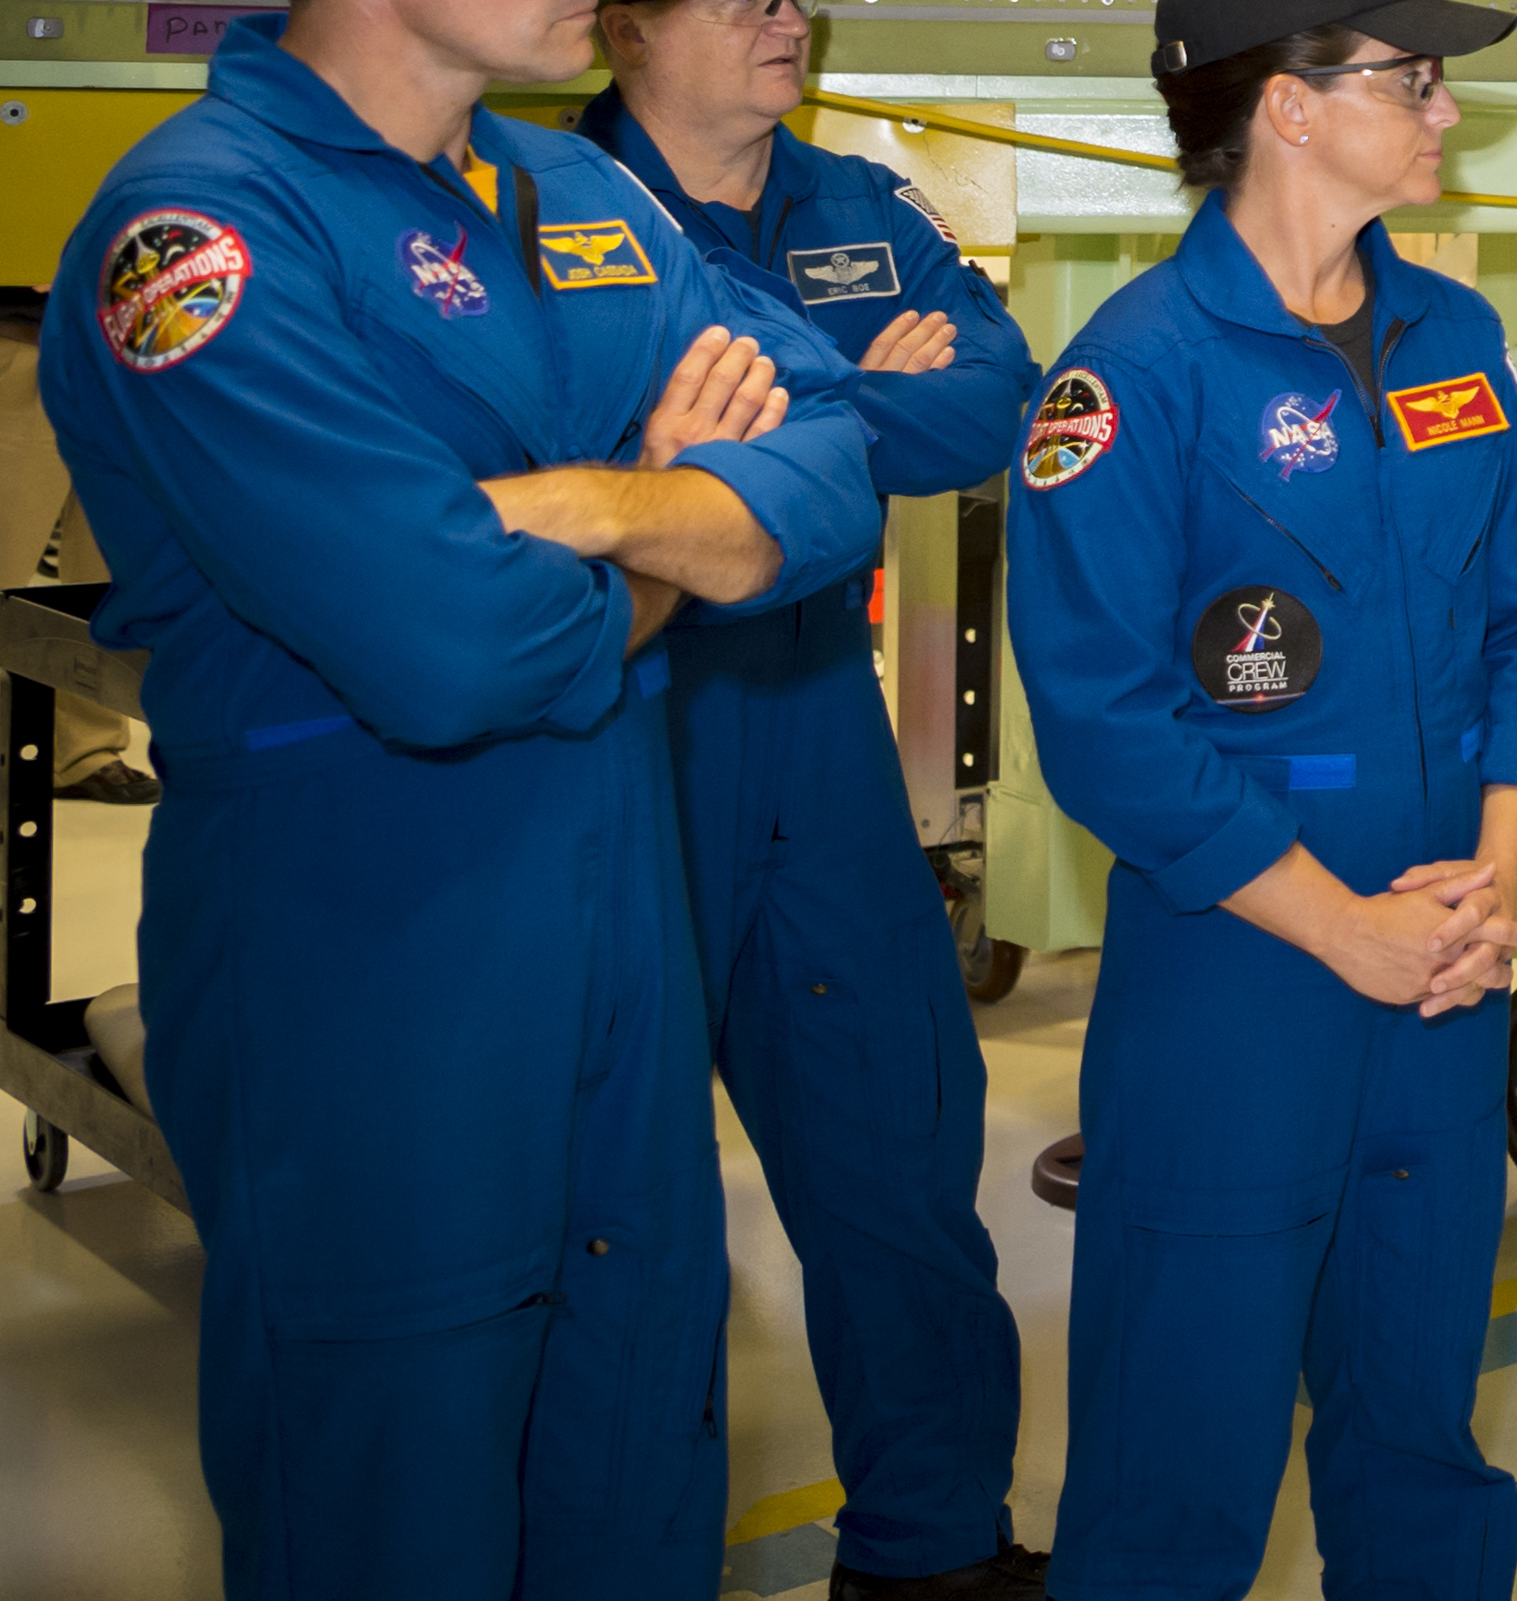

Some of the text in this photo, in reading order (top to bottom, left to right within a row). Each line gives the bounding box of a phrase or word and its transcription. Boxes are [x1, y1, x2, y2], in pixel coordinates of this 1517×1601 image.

[142, 236, 245, 304] OPERATIONS
[827, 283, 871, 296] ERIC BOE
[1048, 412, 1114, 443] OPERATIONS
[1269, 420, 1334, 448] NASA
[1426, 414, 1486, 437] NICOLE MANN
[1226, 651, 1287, 663] COMMERCIAL
[1227, 660, 1287, 682] CREW
[1228, 681, 1288, 692] PROGRAM
